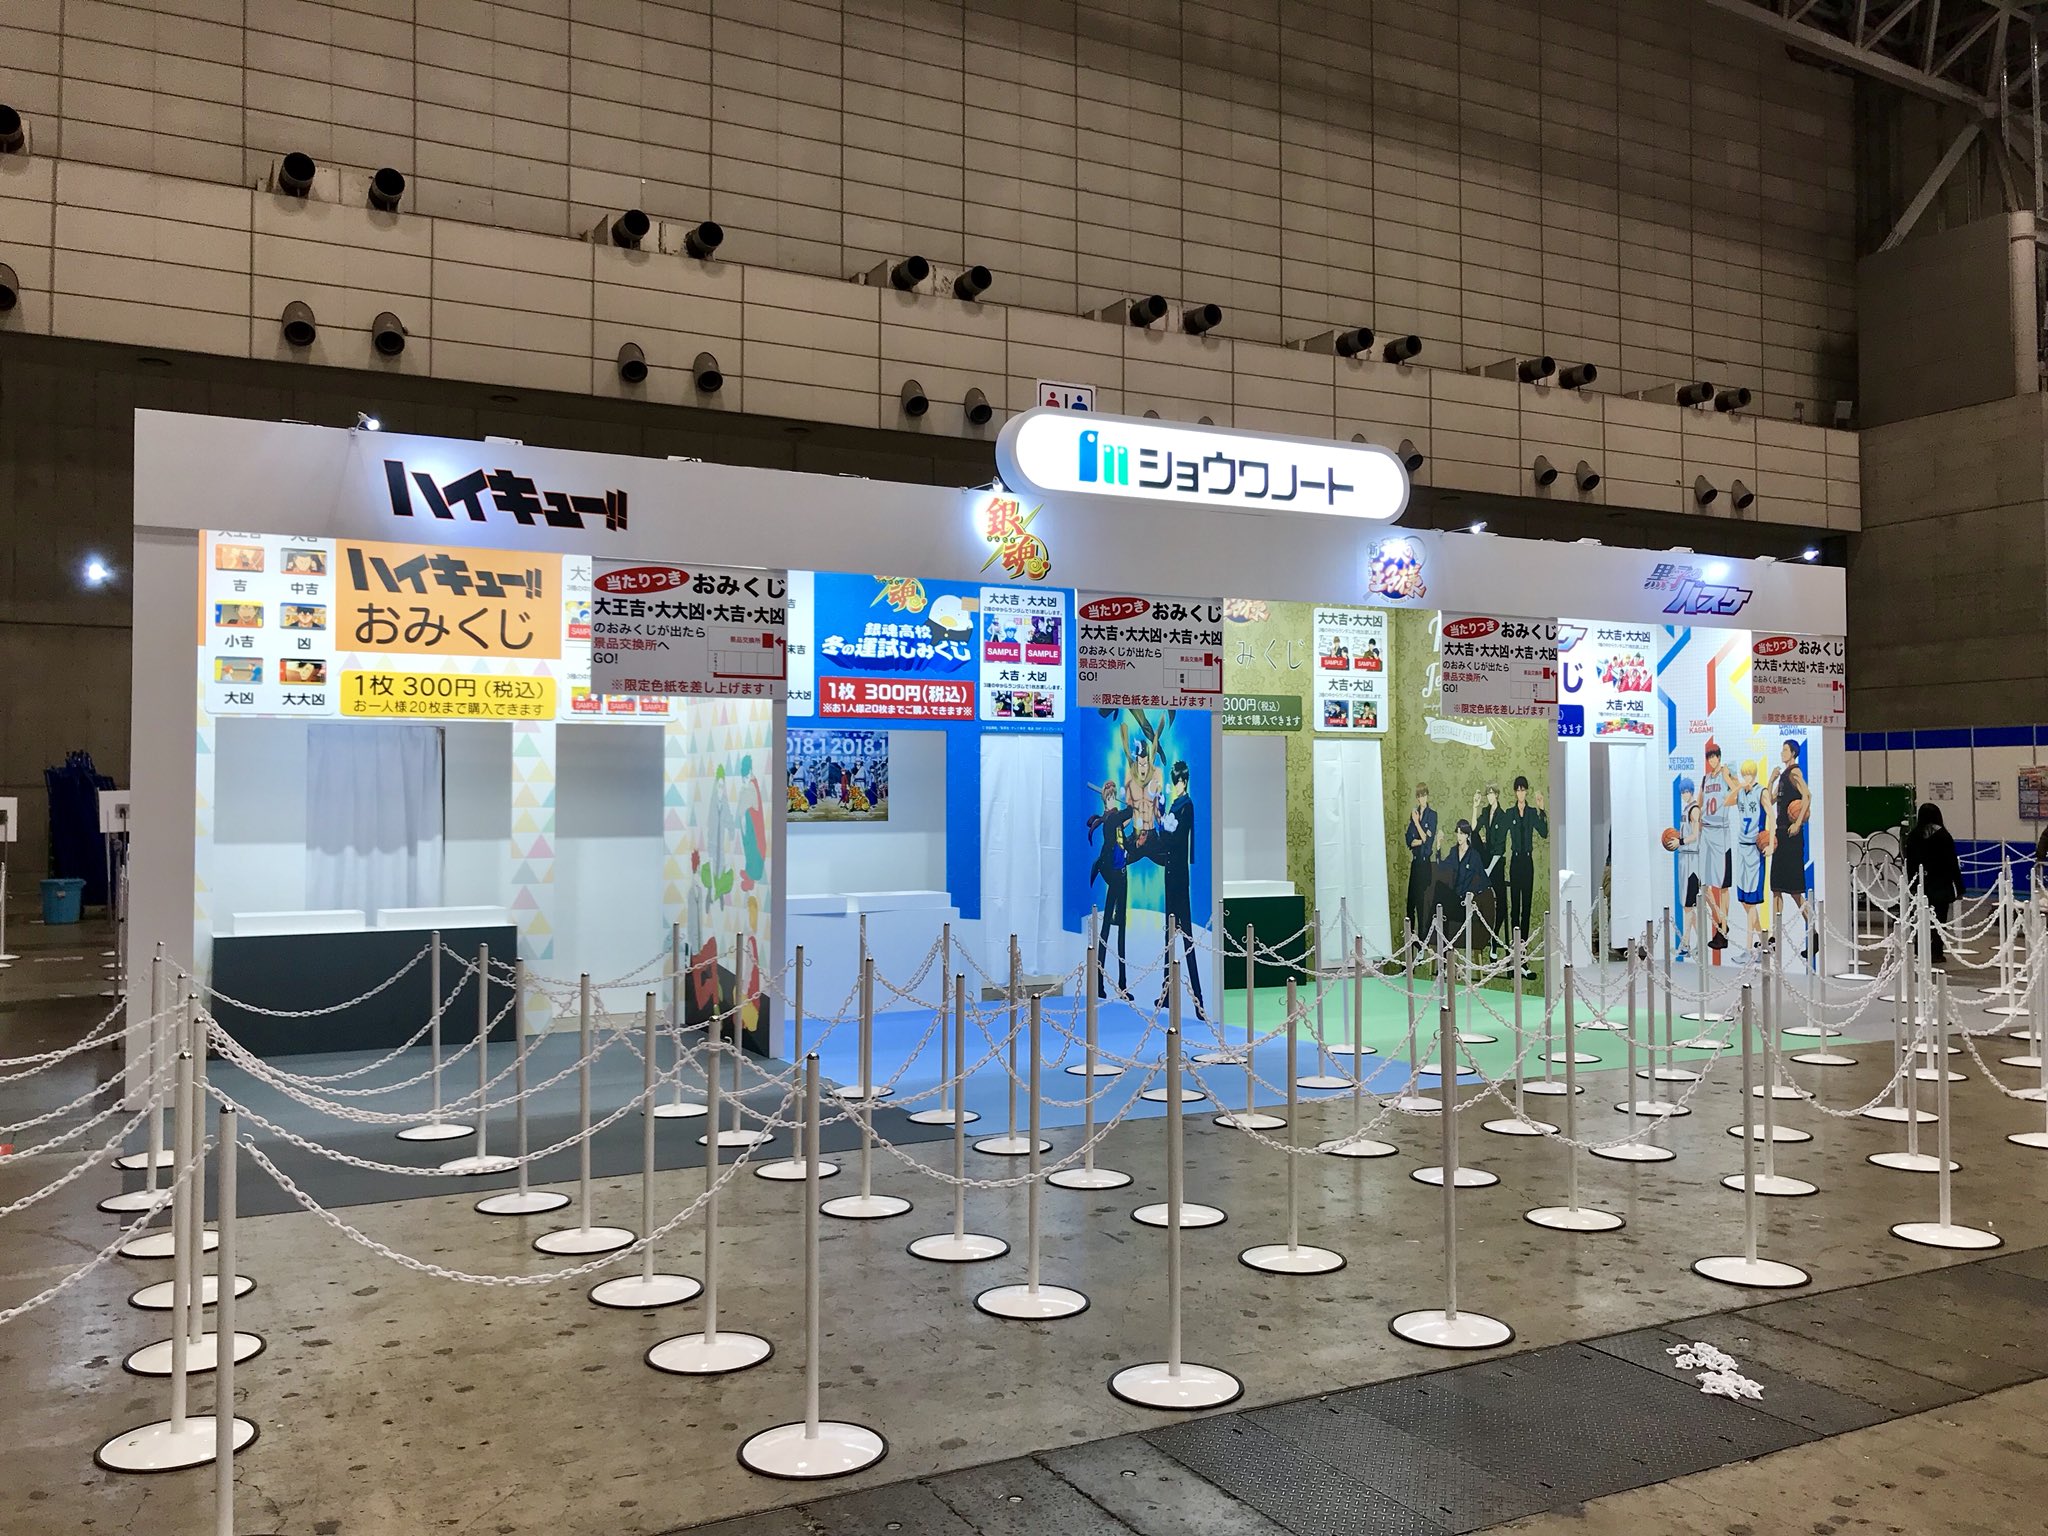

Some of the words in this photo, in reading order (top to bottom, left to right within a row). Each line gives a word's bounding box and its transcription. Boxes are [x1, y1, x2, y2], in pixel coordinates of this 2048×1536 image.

[1139, 448, 1354, 505] ショウワノート
[233, 579, 247, 592] 吉
[291, 582, 319, 596] 中吉
[606, 570, 682, 591] 当たりつき
[692, 573, 786, 599] おみくじ
[1663, 579, 1753, 616] バスケ
[1088, 600, 1144, 618] 当たりつき
[1152, 602, 1222, 623] おみくじ
[355, 603, 534, 650] おみくじ
[594, 622, 706, 638] のおみくじが出たら
[864, 622, 932, 639] 銀魂高校
[1450, 620, 1496, 636] 当たりつき
[1501, 622, 1557, 640] おみくじ
[225, 635, 254, 648] 小吉
[298, 637, 311, 650] 凶
[593, 638, 670, 651] 景品交換所へ
[821, 634, 972, 662] 冬の運試しみくじ
[1758, 639, 1794, 654] 当たりつき
[1799, 641, 1843, 656] おみくじ
[593, 652, 618, 665] GO!
[987, 648, 1018, 656] SAMPLE
[1027, 649, 1058, 658] SAMPLE
[1079, 645, 1162, 658] のおみくじが出たら
[1079, 658, 1136, 670] 景品交換所へ
[1442, 661, 1509, 671] のおみくじが出たら
[1079, 671, 1097, 681] GO!
[1443, 672, 1488, 682] 景品交換所へ
[355, 675, 394, 696] 1枚
[828, 682, 856, 700] 1枚
[1443, 684, 1458, 693] GO!
[224, 691, 254, 705] 大凶
[282, 693, 325, 706] 大大凶
[354, 700, 544, 716] お一人様20枚まで購入できます
[1779, 728, 1807, 736] AOMINE
[1743, 817, 1752, 835] 7
